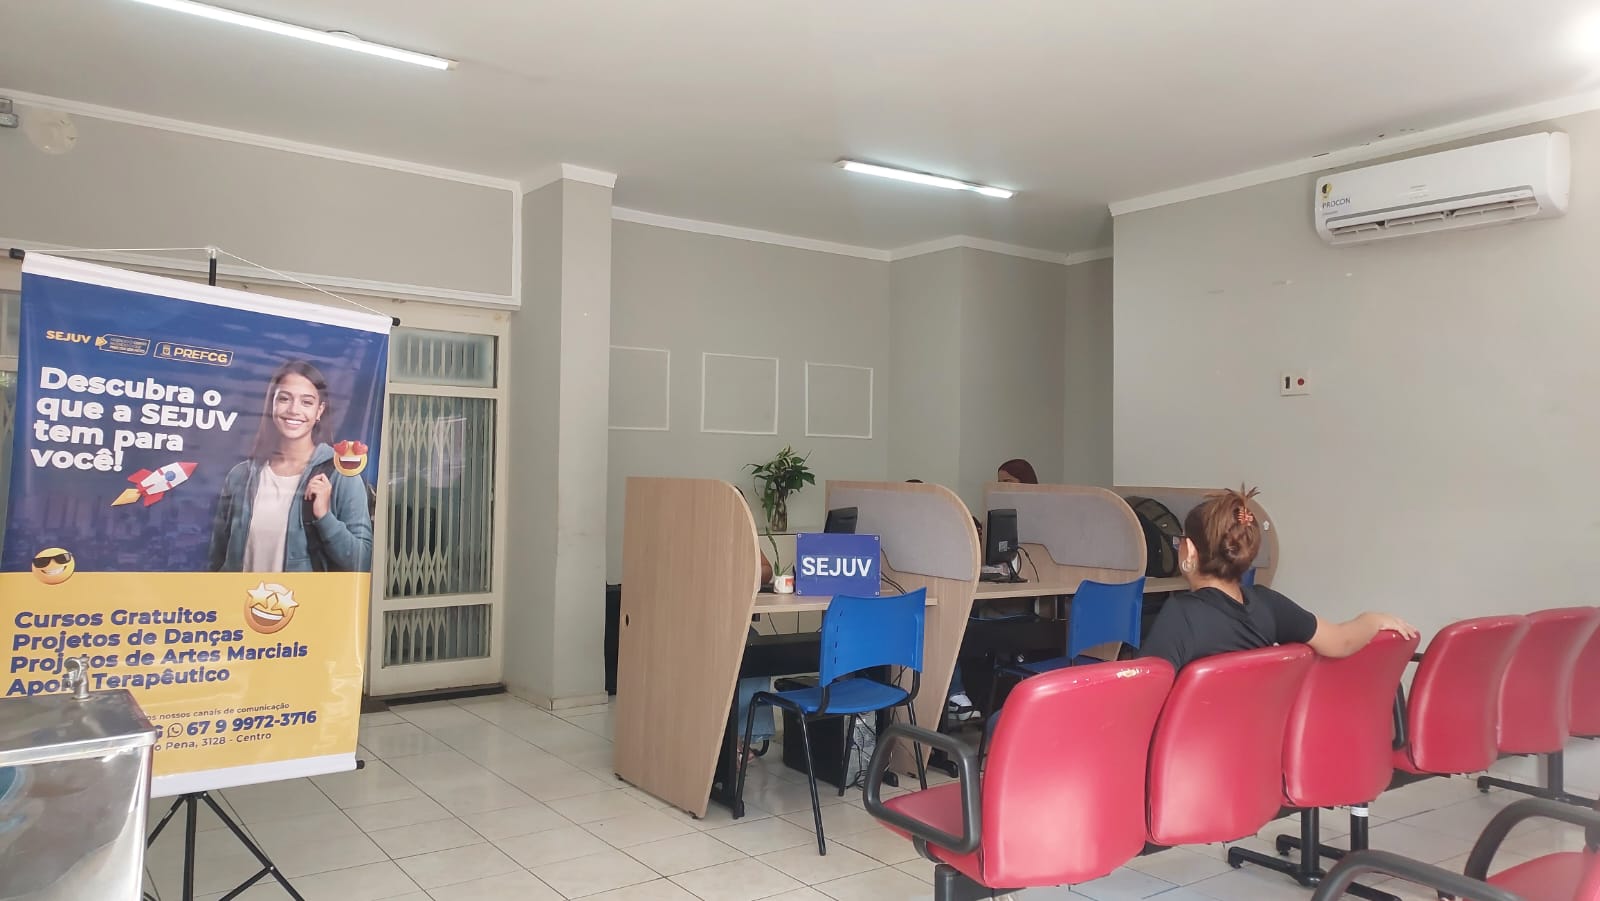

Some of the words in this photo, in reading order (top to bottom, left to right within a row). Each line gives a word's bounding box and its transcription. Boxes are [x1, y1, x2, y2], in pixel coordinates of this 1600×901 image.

[46, 330, 91, 344] SEJUV
[174, 347, 228, 363] PREFCG
[40, 367, 195, 404] Descubra
[203, 390, 221, 406] o
[37, 396, 104, 421] que
[112, 404, 131, 422] a
[140, 403, 238, 432] SEJUV
[34, 419, 104, 445] tem
[114, 429, 184, 451] para
[31, 448, 124, 472] você!
[801, 557, 872, 577] SEJUV
[15, 611, 103, 629] Cursos
[111, 606, 217, 626] Gratuitos
[13, 630, 120, 653] Projetos
[127, 629, 157, 646] de
[164, 627, 244, 647] Danças
[10, 653, 118, 674] Projos
[125, 649, 155, 667] de
[160, 646, 221, 665] Artes
[227, 641, 308, 661] Marciais
[6, 673, 72, 696] Apoi
[92, 666, 230, 690] Terapêutico
[160, 712, 191, 720] nossos
[193, 708, 222, 717] canais
[224, 706, 235, 715] de
[237, 702, 290, 714] comunicação
[186, 720, 211, 736] 67
[215, 719, 227, 734] 9
[232, 711, 317, 732] 9972-3716
[165, 741, 198, 752] Pena,
[202, 736, 226, 747] 3128
[236, 732, 272, 743] Centro
